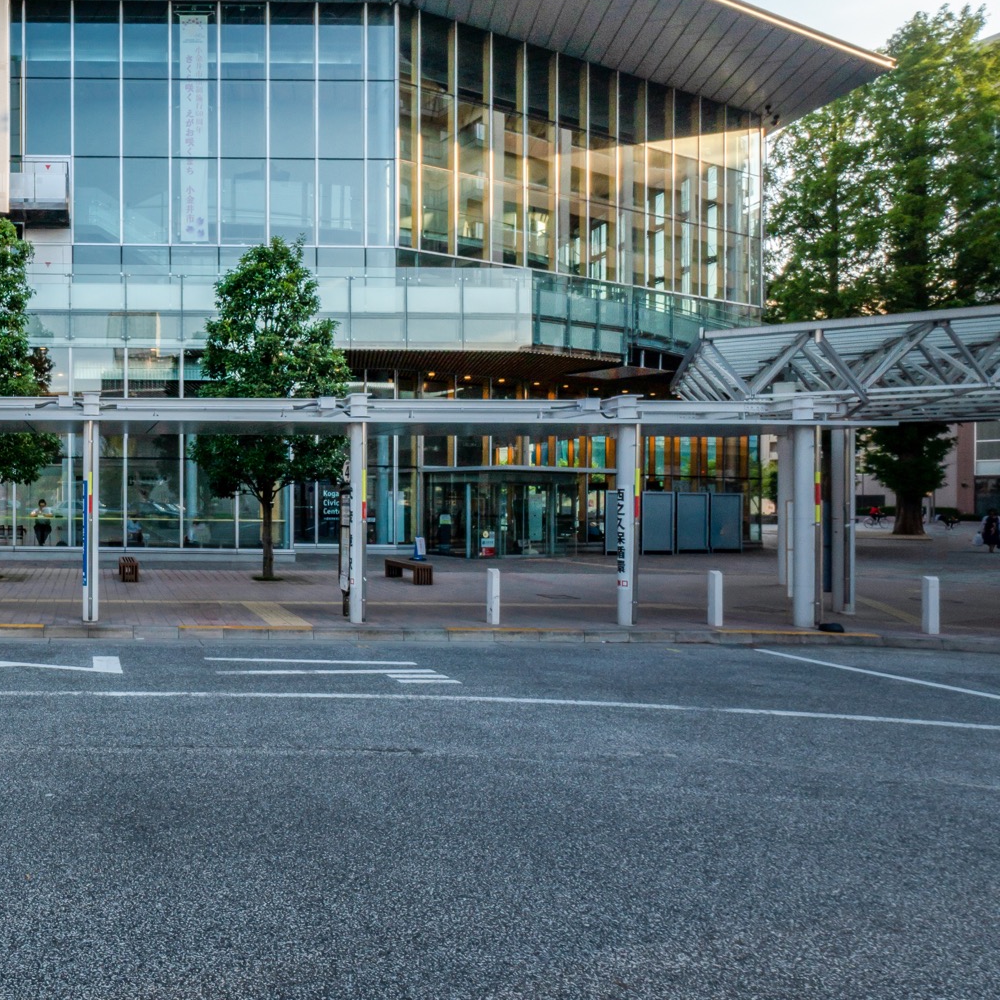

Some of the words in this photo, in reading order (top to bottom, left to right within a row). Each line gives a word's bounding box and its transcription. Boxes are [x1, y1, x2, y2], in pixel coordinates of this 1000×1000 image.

[185, 185, 195, 223] 小金井市
[323, 490, 339, 498] Koga
